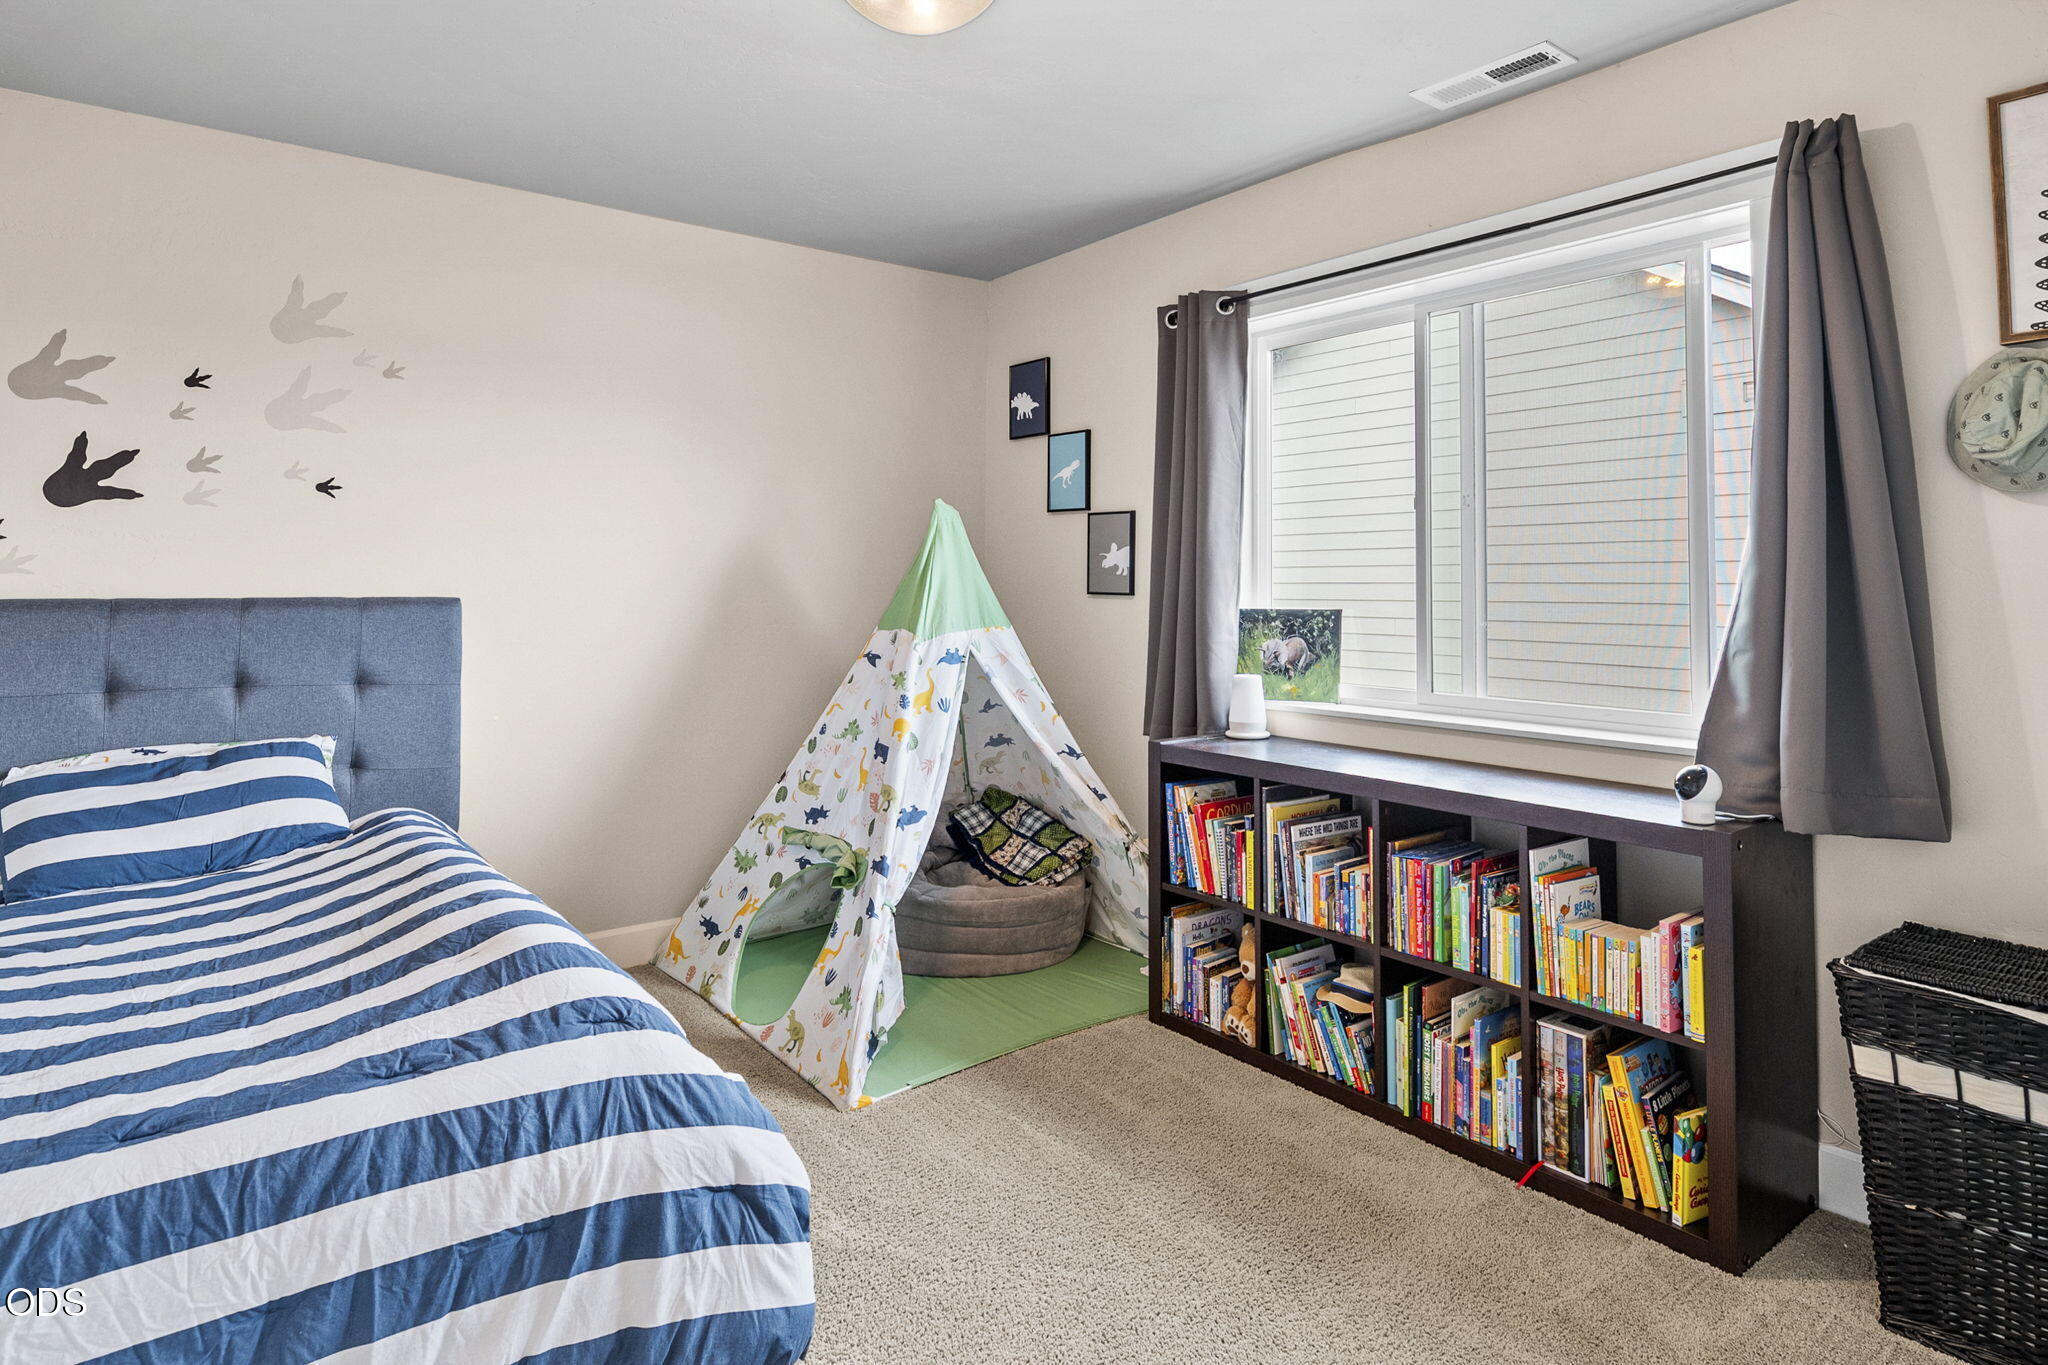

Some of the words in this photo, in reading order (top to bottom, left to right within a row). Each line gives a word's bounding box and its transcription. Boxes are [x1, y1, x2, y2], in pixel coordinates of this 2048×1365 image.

[1299, 826, 1313, 838] WHERE
[1314, 825, 1322, 835] THE
[1322, 822, 1333, 834] WILD
[1333, 820, 1349, 832] THINGS
[1349, 818, 1358, 829] ARE
[1574, 900, 1596, 915] BEARS
[1191, 913, 1232, 930] DRAGONS
[1652, 1100, 1658, 1112] 8
[1657, 1091, 1672, 1109] Little
[1645, 1110, 1655, 1132] LITTLE
[1651, 1131, 1663, 1163] PLANETS
